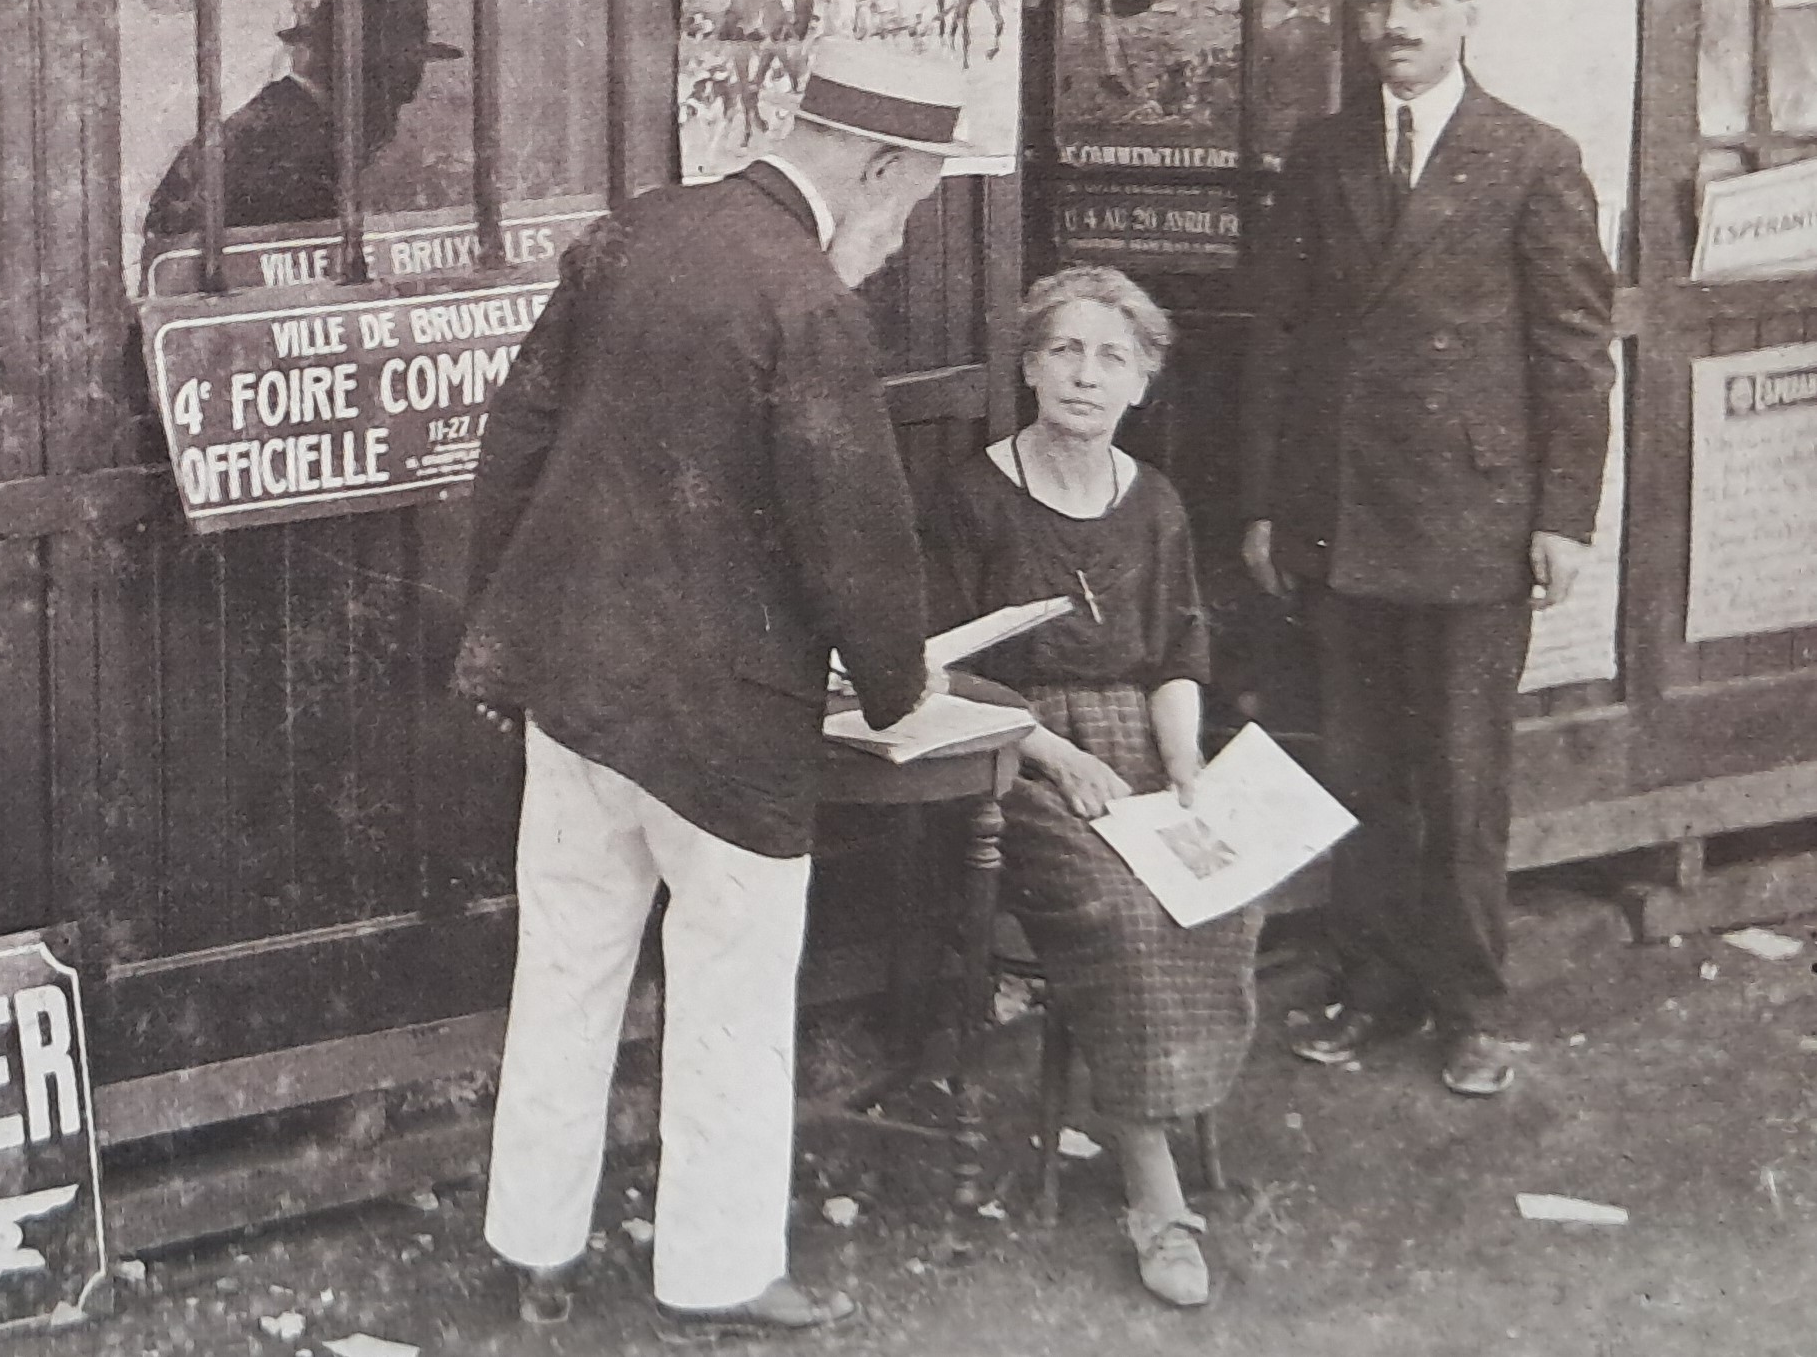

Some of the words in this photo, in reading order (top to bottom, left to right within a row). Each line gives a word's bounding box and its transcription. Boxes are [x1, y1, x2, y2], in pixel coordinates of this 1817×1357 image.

[260, 248, 329, 288] VILLE
[390, 228, 554, 276] BRUXLES
[272, 317, 347, 359] VILLE
[359, 311, 399, 350] DE
[409, 294, 550, 343] BRUXELL
[230, 362, 360, 431] FOIRE
[381, 344, 521, 415] COMM
[183, 427, 390, 504] OFFICIELLE
[428, 415, 471, 442] 11-27
